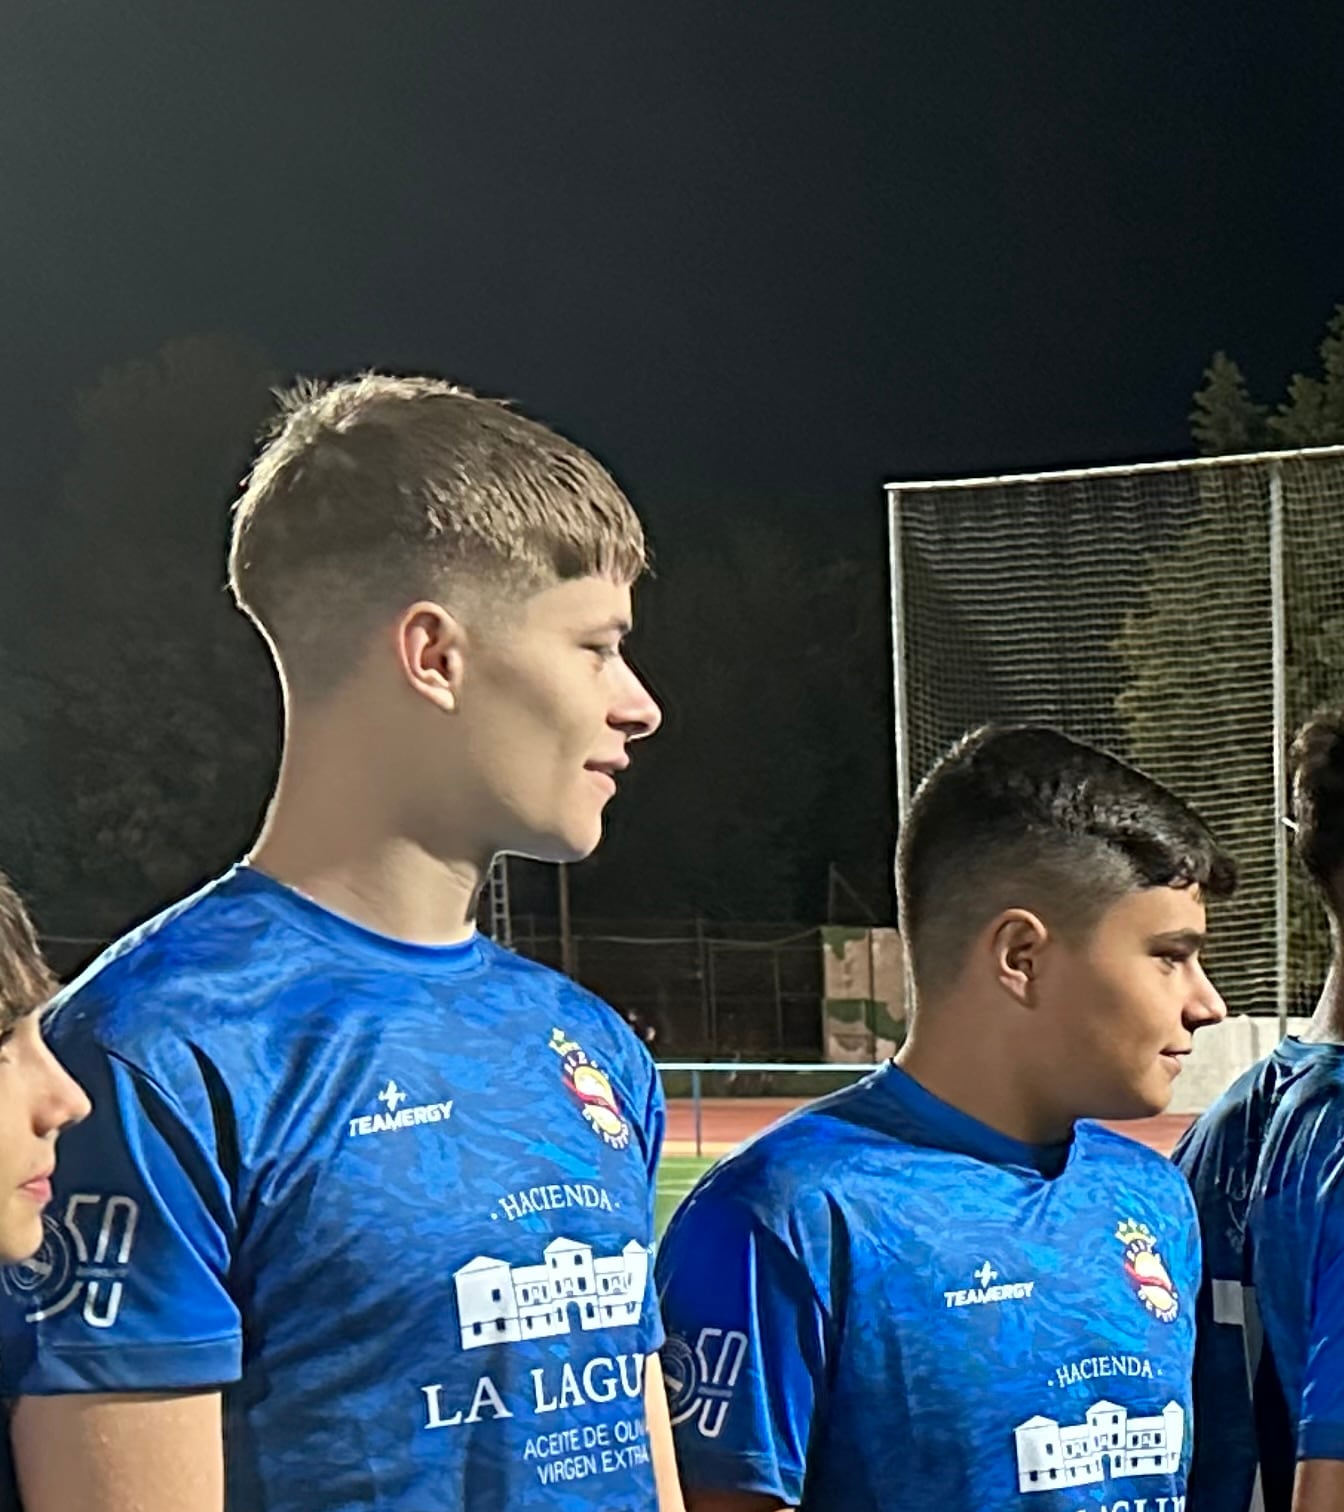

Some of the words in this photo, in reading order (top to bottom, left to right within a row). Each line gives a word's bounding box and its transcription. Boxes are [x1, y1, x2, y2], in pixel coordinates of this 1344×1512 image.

[349, 1100, 454, 1138] TEAMERGY
[498, 1184, 612, 1221] HACIENDA
[943, 1281, 1036, 1308] TEAMERGY
[1055, 1355, 1155, 1388] HACIENDA
[420, 1376, 515, 1430] LA
[530, 1352, 646, 1415] LAGU
[523, 1428, 580, 1461] ACEITE
[583, 1424, 610, 1450] DE
[537, 1454, 597, 1486] VIRGEN
